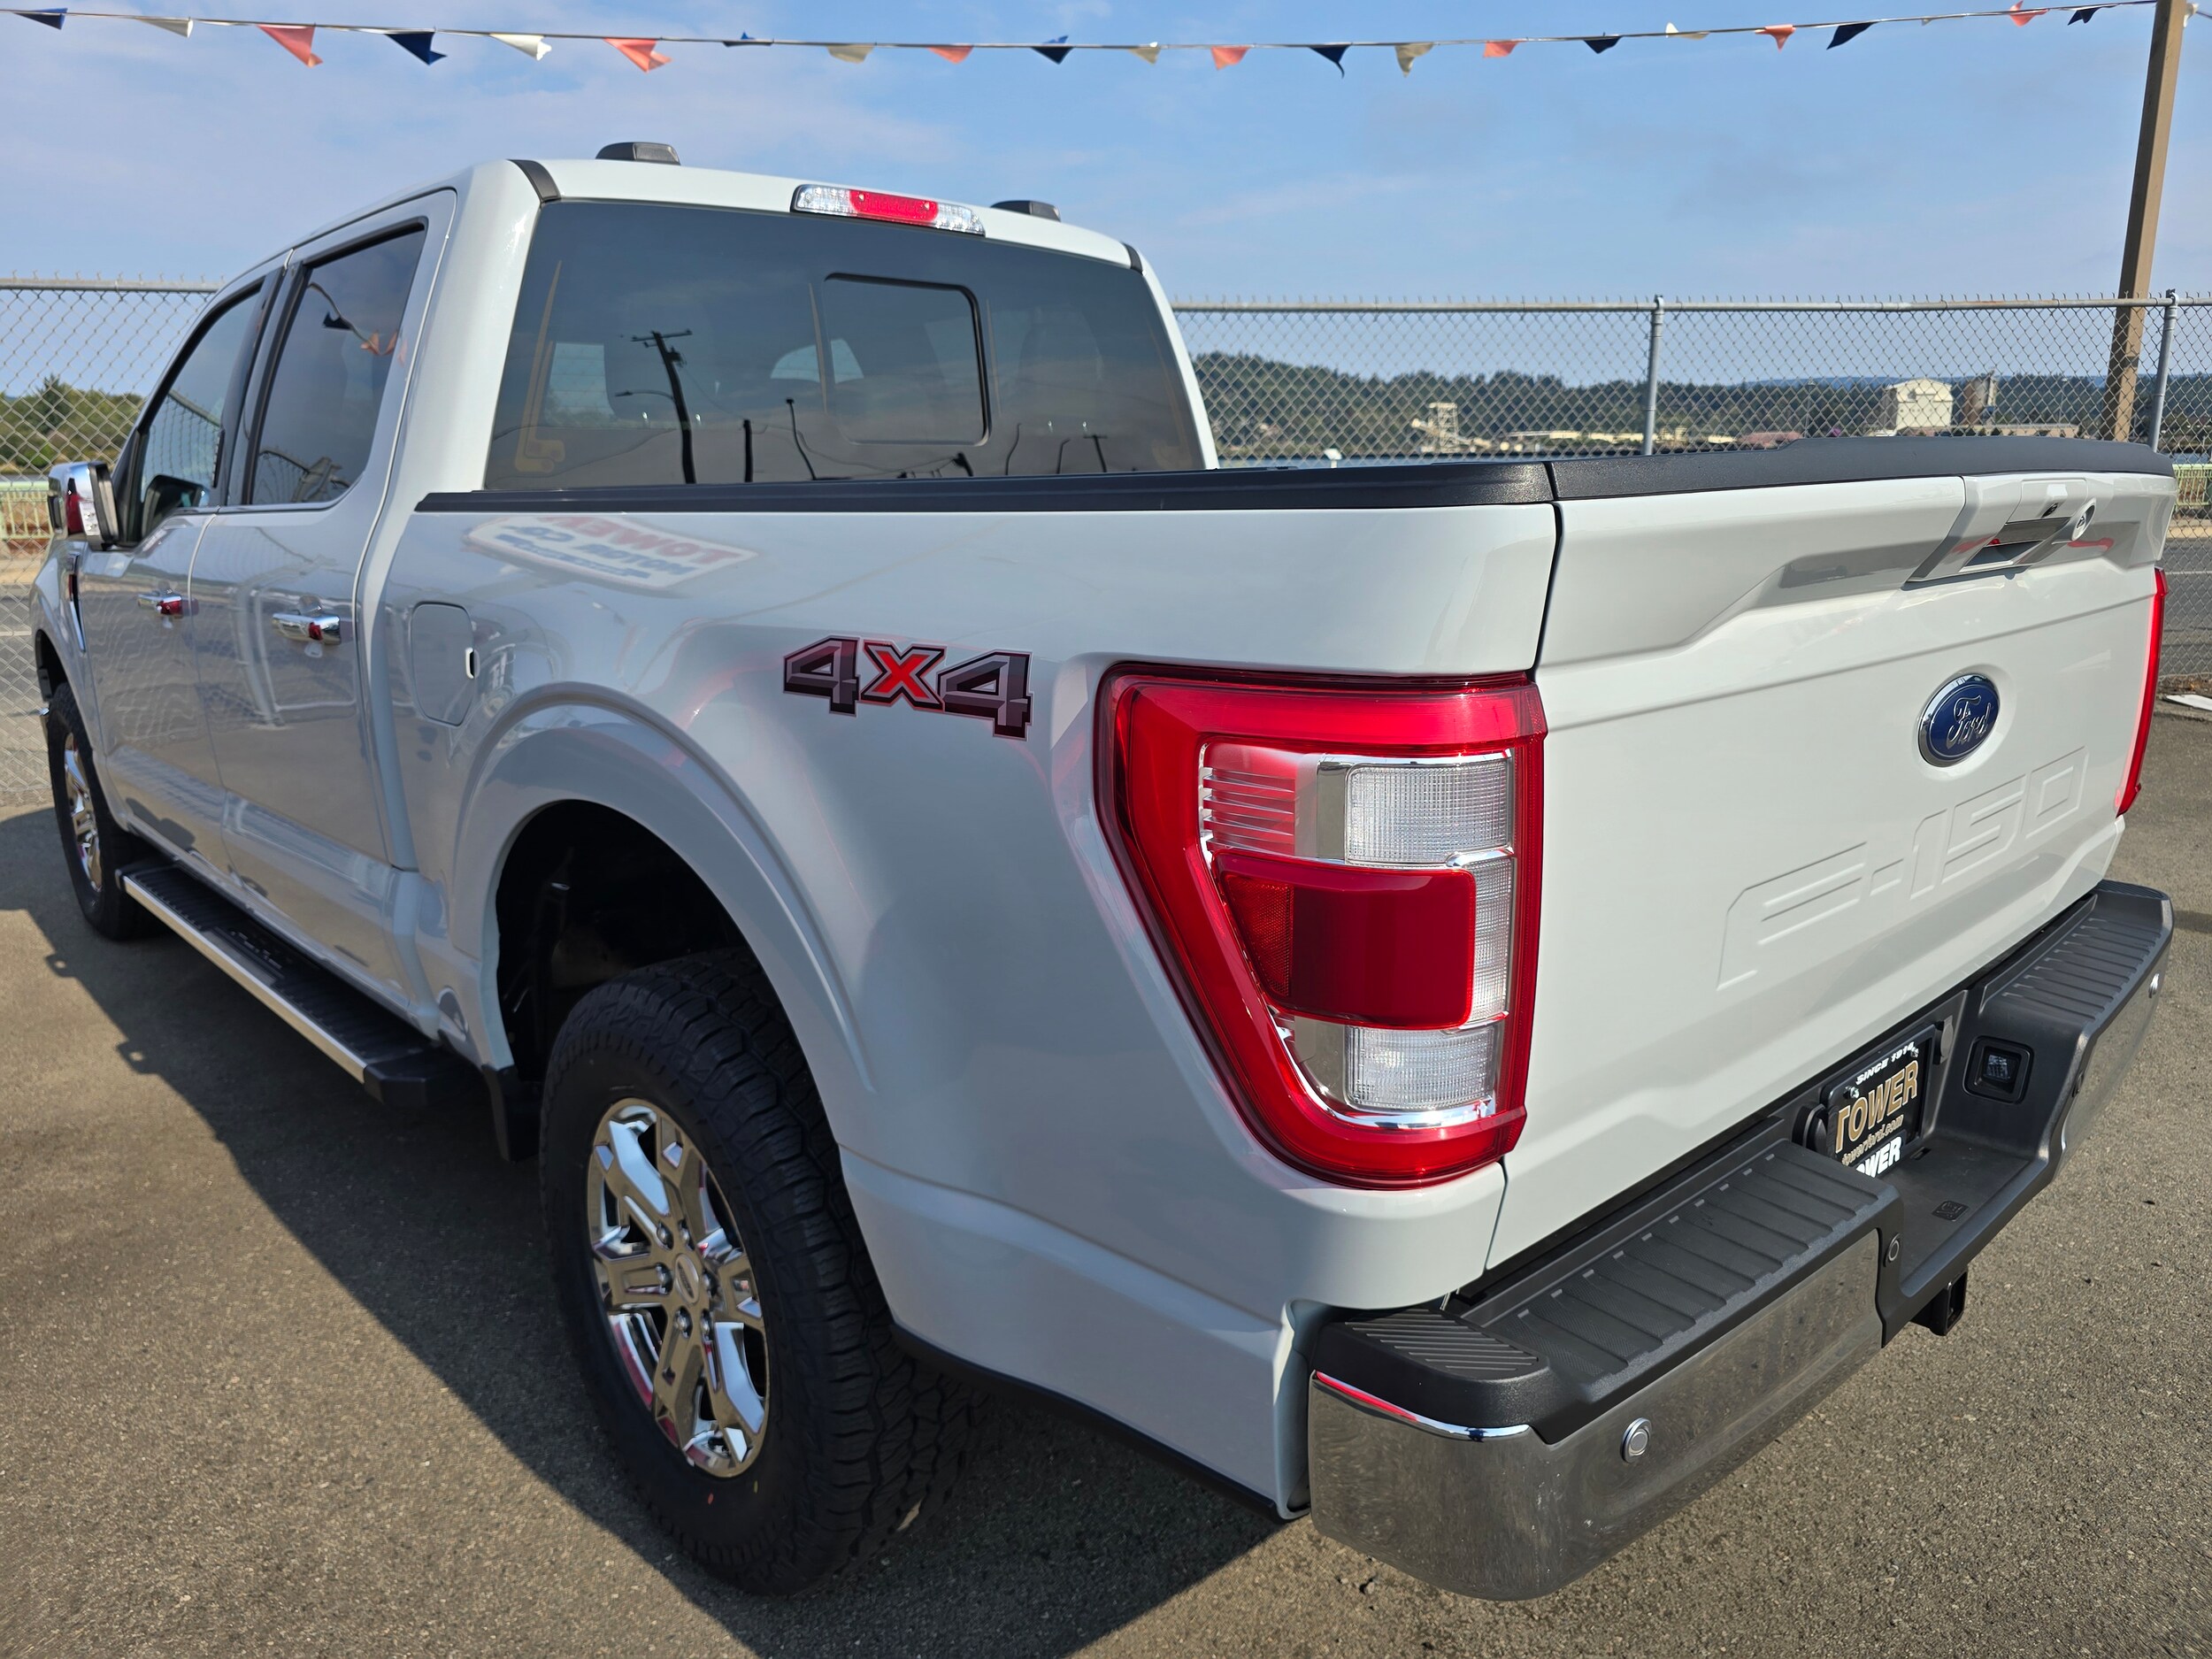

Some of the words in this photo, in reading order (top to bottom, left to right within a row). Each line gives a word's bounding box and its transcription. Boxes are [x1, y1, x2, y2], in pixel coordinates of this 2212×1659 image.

[1947, 695, 1992, 749] Ford
[1717, 746, 2089, 991] F-150
[1836, 1060, 1919, 1154] TOWER
[1855, 1057, 1889, 1085] SINCE
